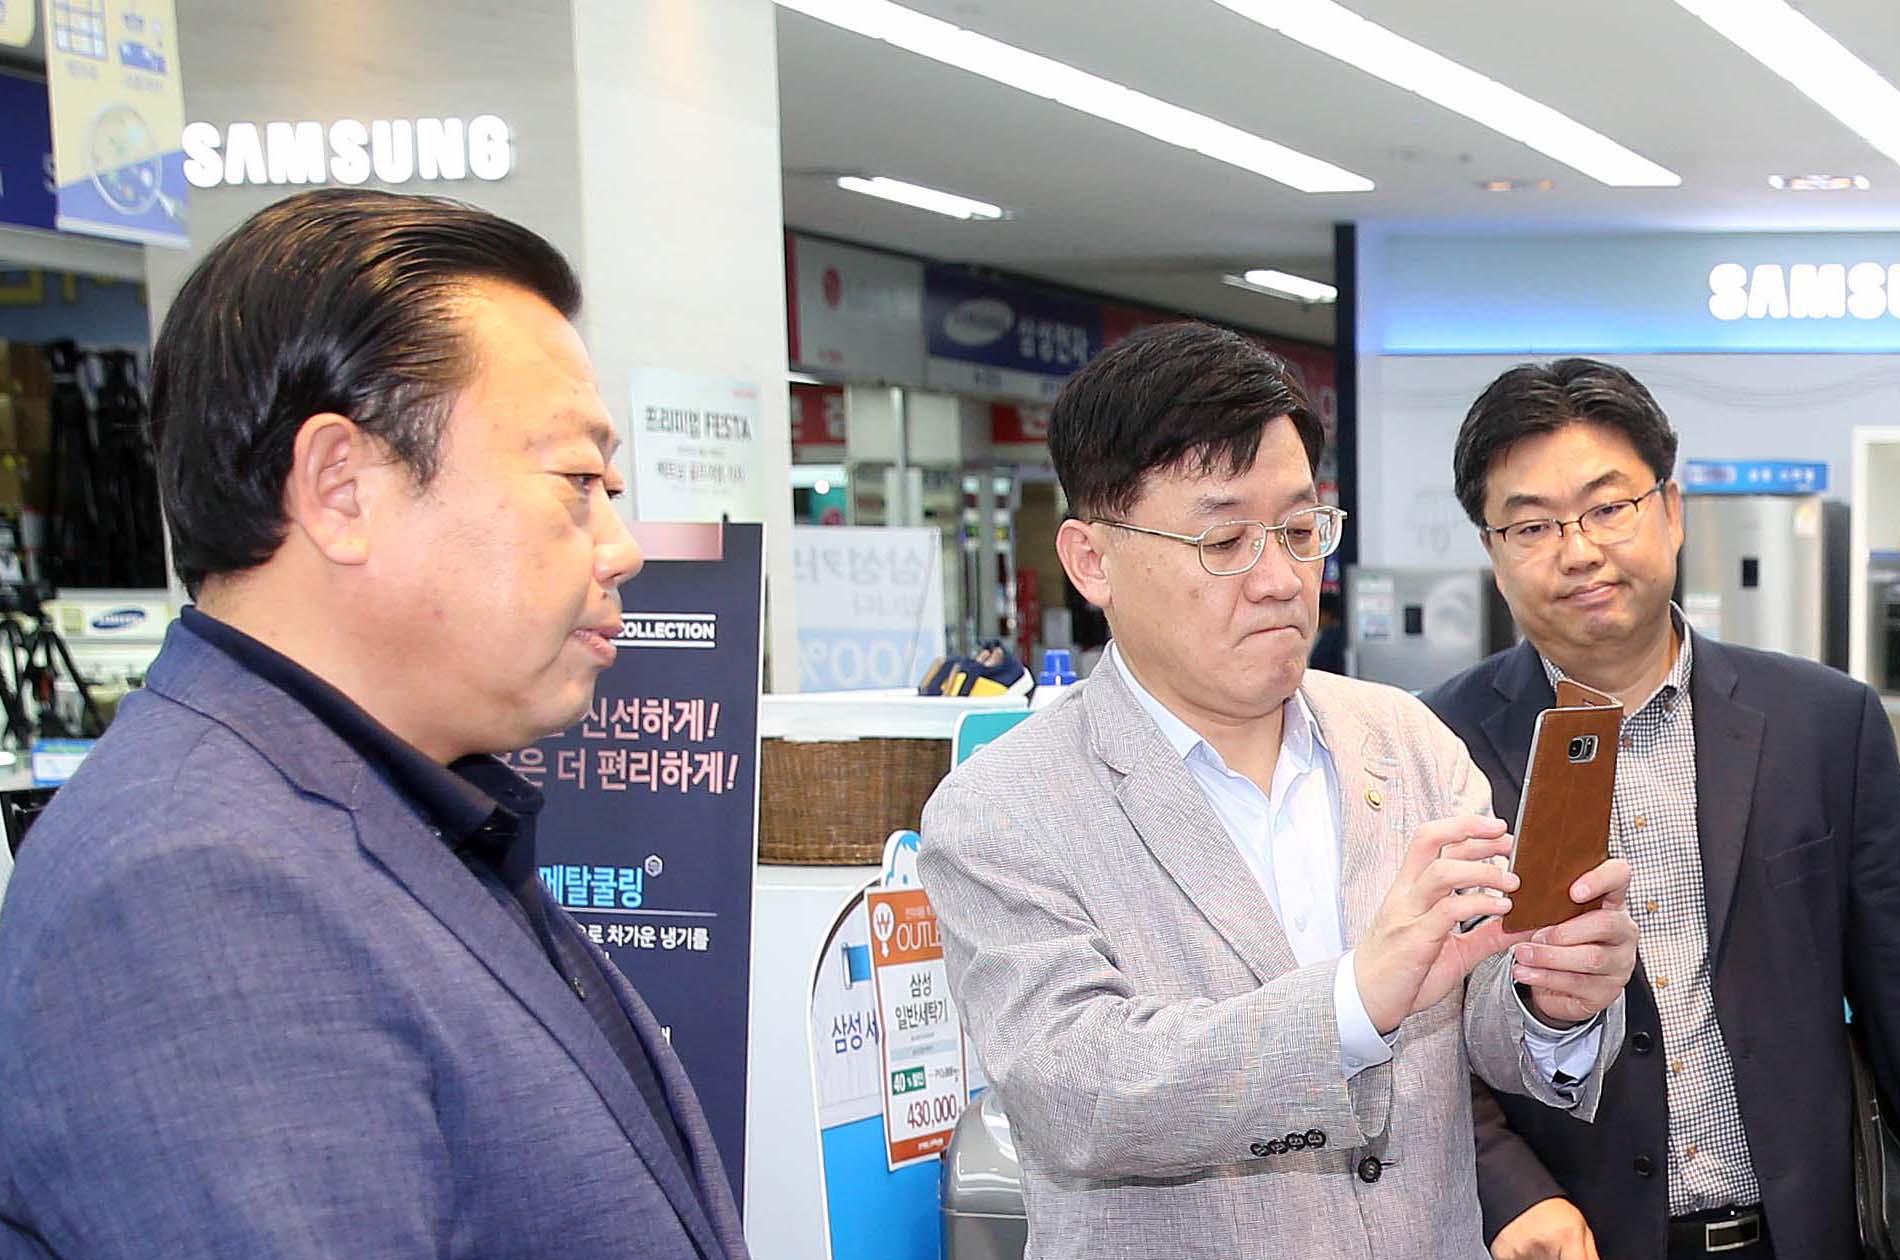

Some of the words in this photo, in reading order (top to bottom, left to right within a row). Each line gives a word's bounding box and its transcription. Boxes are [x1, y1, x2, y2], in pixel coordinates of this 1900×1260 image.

[182, 115, 512, 187] SAMSUNG
[580, 697, 721, 743] 신선하게!
[557, 748, 587, 790] 더
[597, 748, 739, 794] 편리하게!
[607, 925, 657, 948] 차가운
[910, 971, 932, 998] 삼성
[831, 1010, 863, 1055] 삼성
[894, 998, 949, 1031] 일반세탁기
[906, 1093, 958, 1129] 430,000
